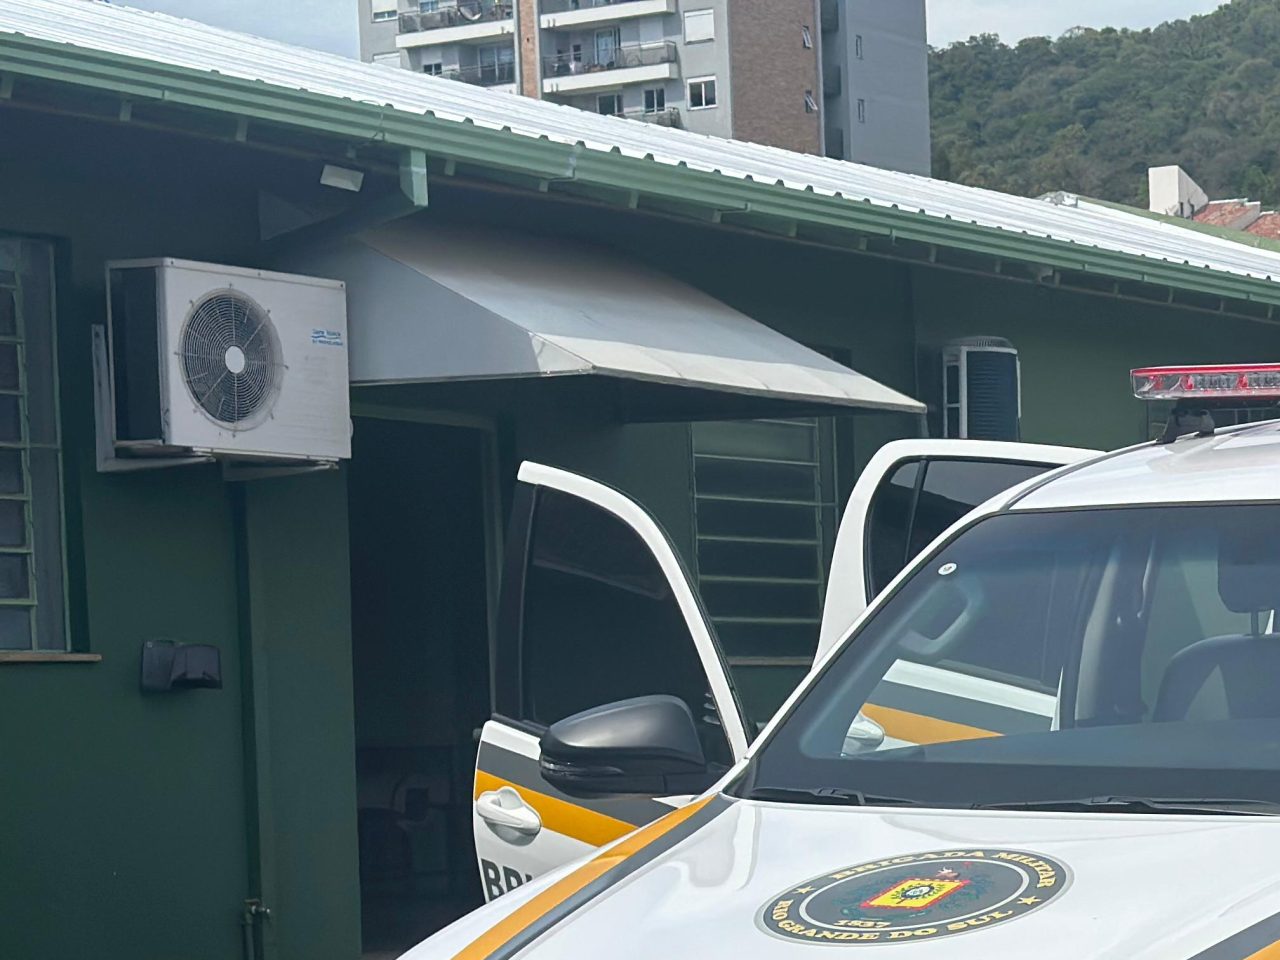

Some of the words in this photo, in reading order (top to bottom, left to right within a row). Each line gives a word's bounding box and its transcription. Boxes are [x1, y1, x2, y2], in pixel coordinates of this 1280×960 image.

[830, 850, 986, 880] BRIGADA
[989, 851, 1056, 889] MILITAR
[772, 900, 794, 921] RIO
[946, 908, 1015, 931] SUL
[776, 918, 880, 941] GRANDE
[888, 927, 938, 940] DO
